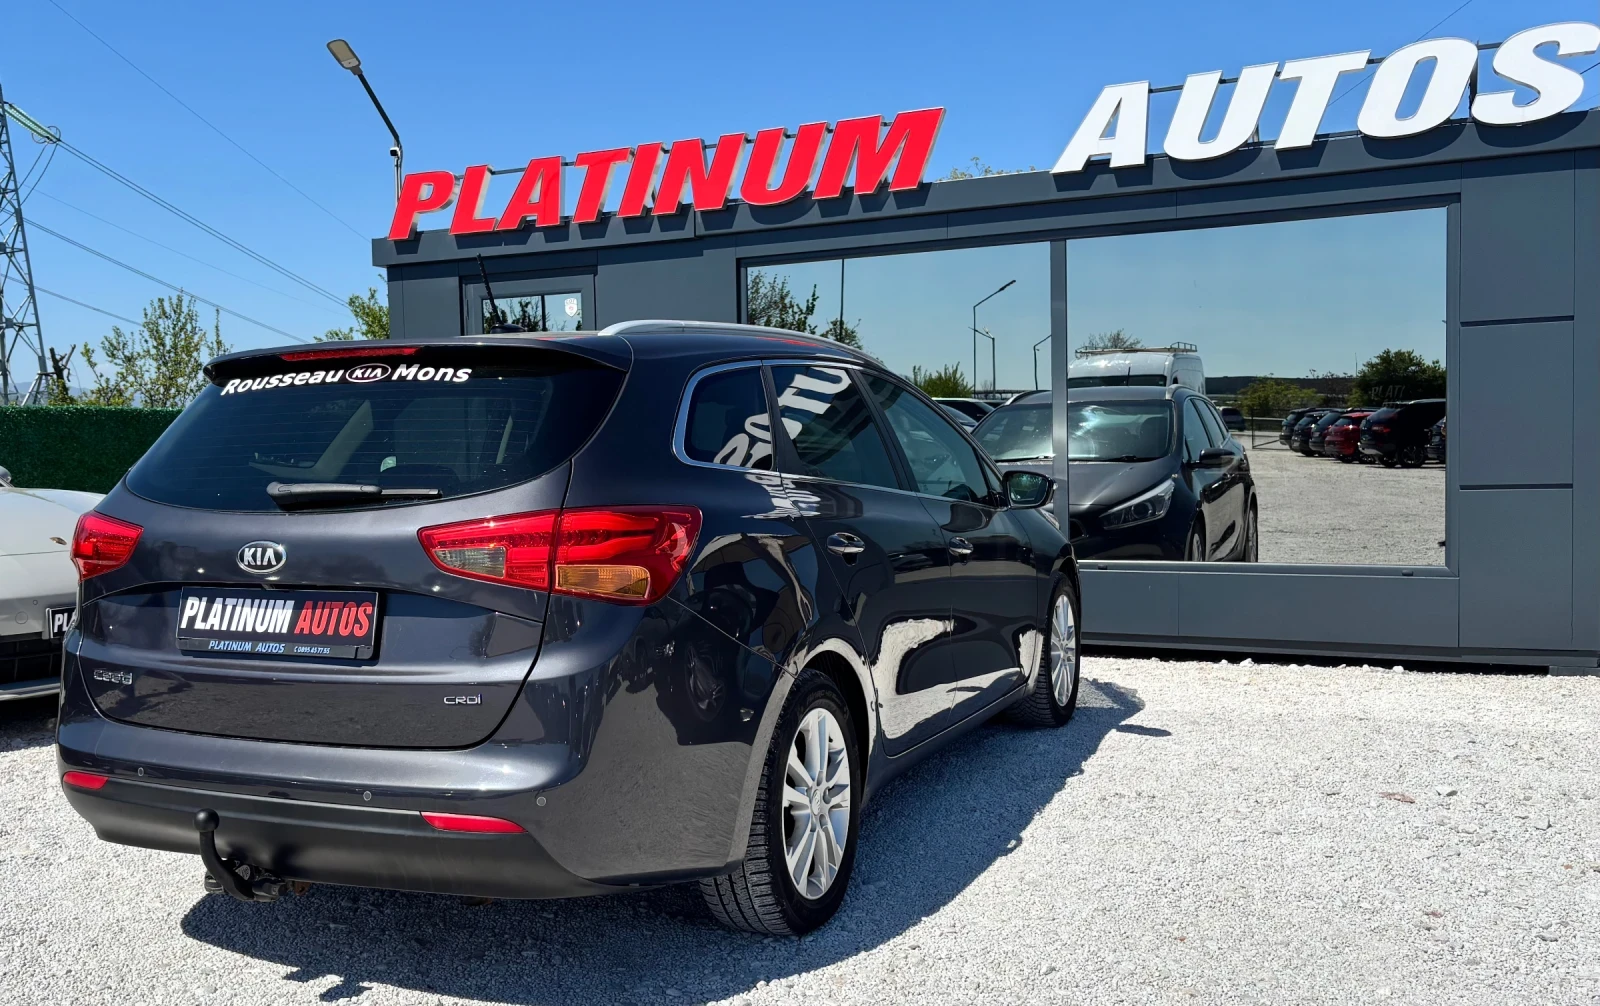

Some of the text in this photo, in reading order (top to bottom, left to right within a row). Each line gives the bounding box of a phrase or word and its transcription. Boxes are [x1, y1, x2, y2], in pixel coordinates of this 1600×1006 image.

[388, 20, 1600, 240] PLATINUM AUTOS
[220, 363, 473, 396] Rousseau KIA Mons
[243, 547, 278, 566] KIA
[180, 596, 373, 637] PLATINUM AUTOS
[208, 640, 252, 652] PLATINUM
[255, 642, 286, 654] AUTOS
